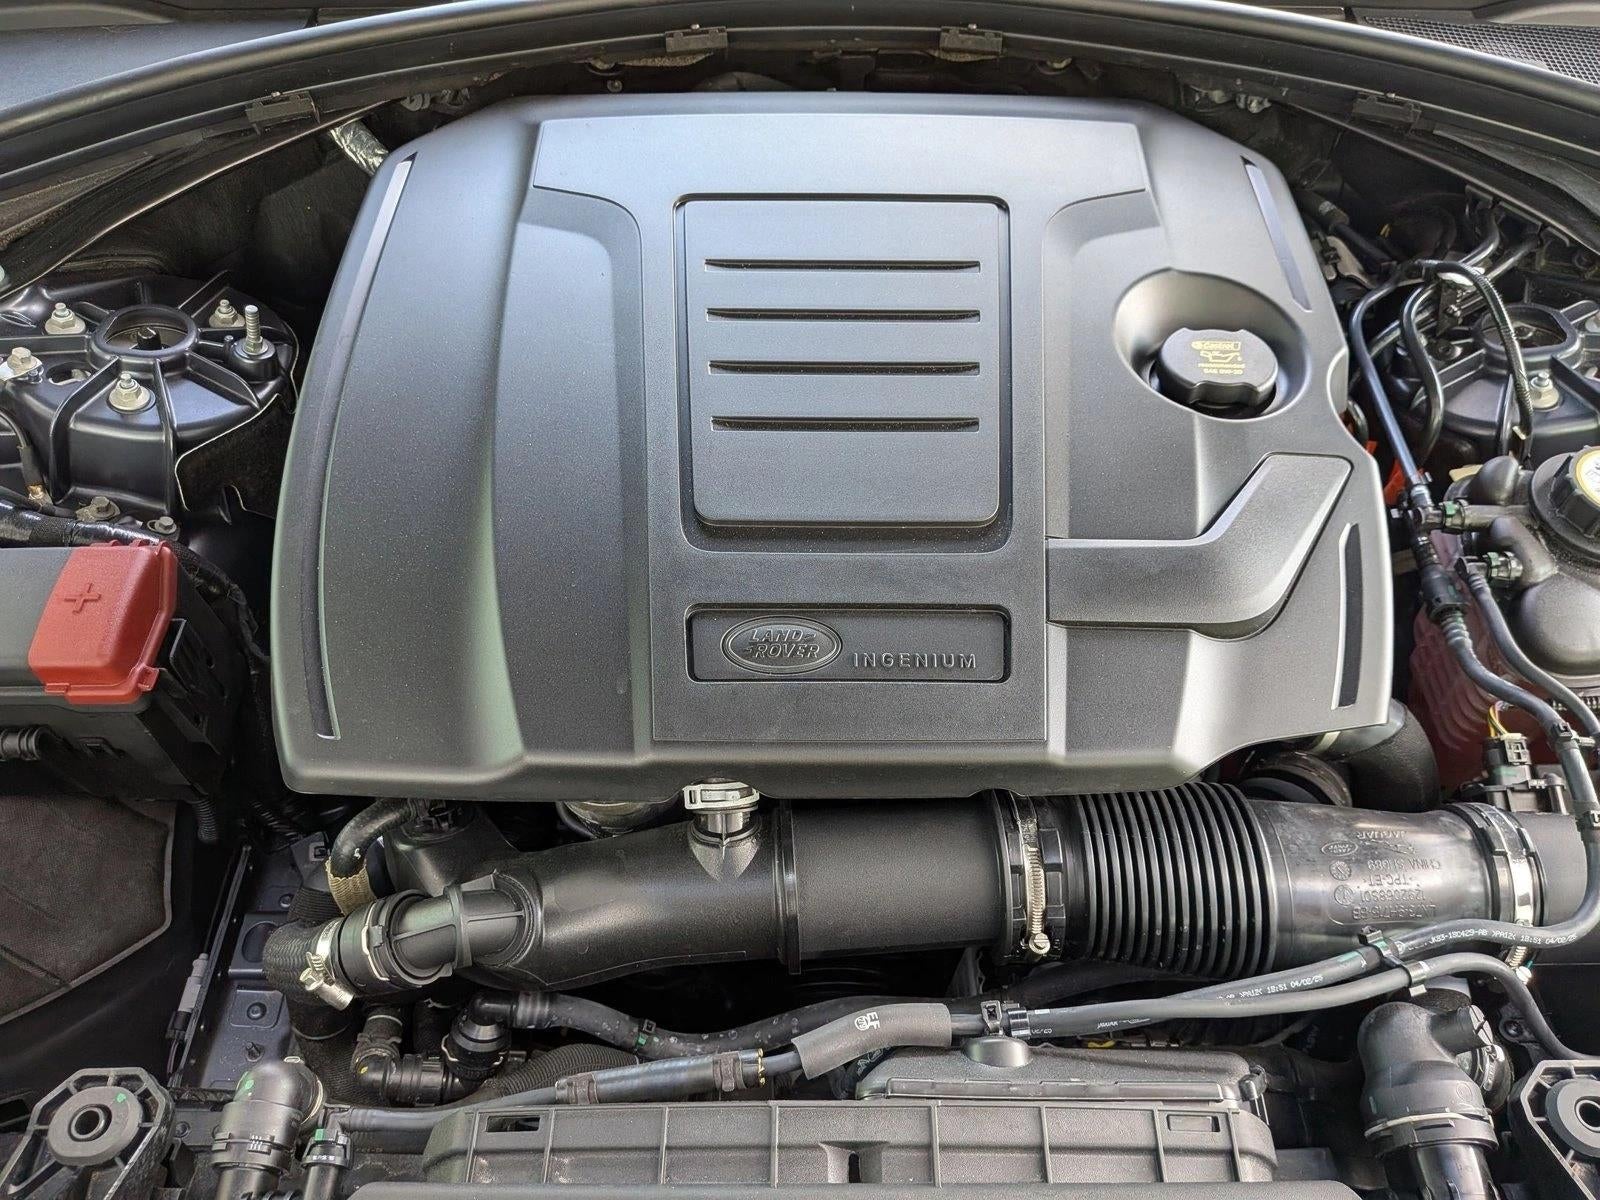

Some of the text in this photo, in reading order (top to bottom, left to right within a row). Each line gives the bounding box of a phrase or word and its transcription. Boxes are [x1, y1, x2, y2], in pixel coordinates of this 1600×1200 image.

[750, 628, 804, 643] LAND
[752, 643, 820, 659] ROVER
[853, 652, 977, 669] INGENIUM
